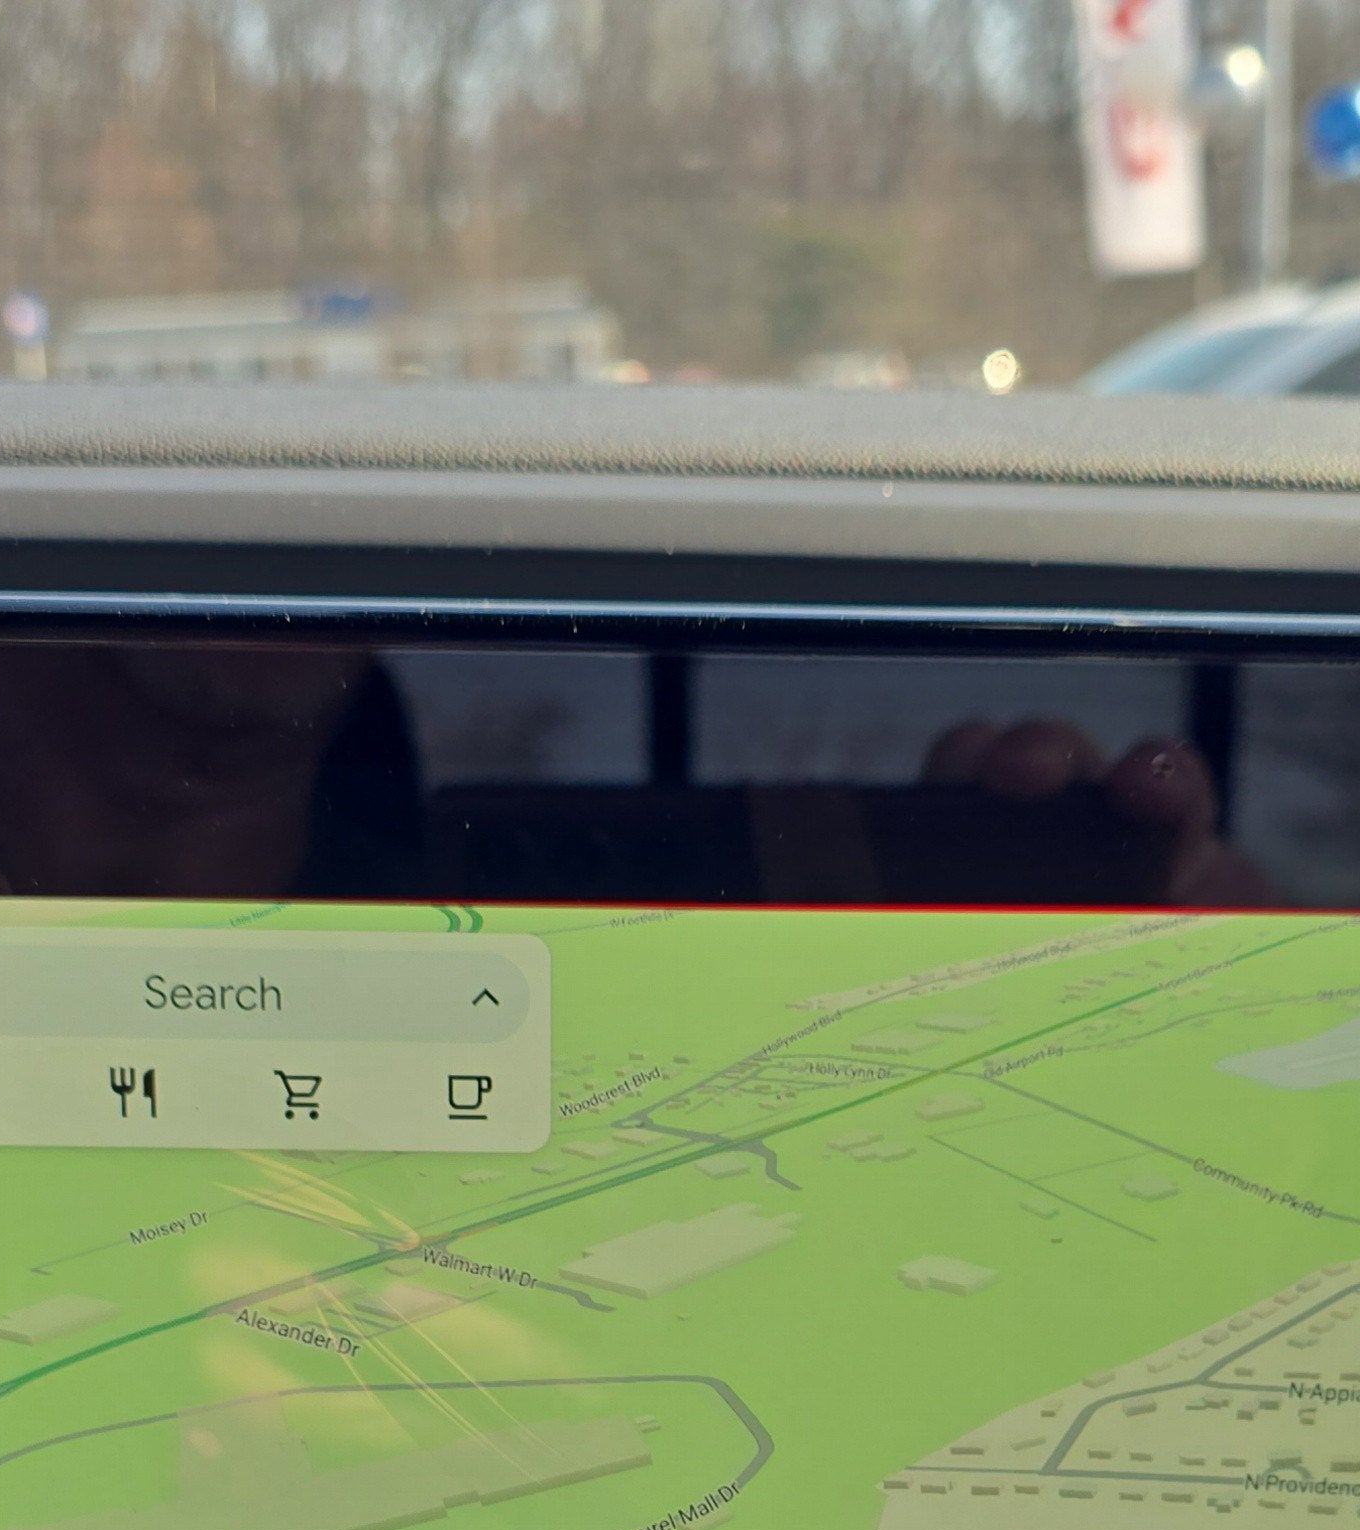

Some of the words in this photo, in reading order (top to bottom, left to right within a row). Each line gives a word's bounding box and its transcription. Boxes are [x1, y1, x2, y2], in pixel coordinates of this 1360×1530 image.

[143, 975, 283, 1012] Search
[559, 1078, 631, 1119] Woodcrest
[630, 1066, 662, 1088] Blvd
[1192, 1157, 1277, 1205] Community
[129, 1218, 188, 1247] Moisey
[189, 1210, 210, 1228] Dr
[423, 1246, 494, 1279] Walmart
[497, 1266, 518, 1284] W
[518, 1271, 540, 1290] Dr
[236, 1307, 335, 1350] Alexander
[337, 1335, 361, 1358] Dr
[1288, 1382, 1303, 1399] N
[677, 1493, 719, 1527] Mall
[718, 1480, 742, 1505] Dr
[1244, 1474, 1260, 1491] N
